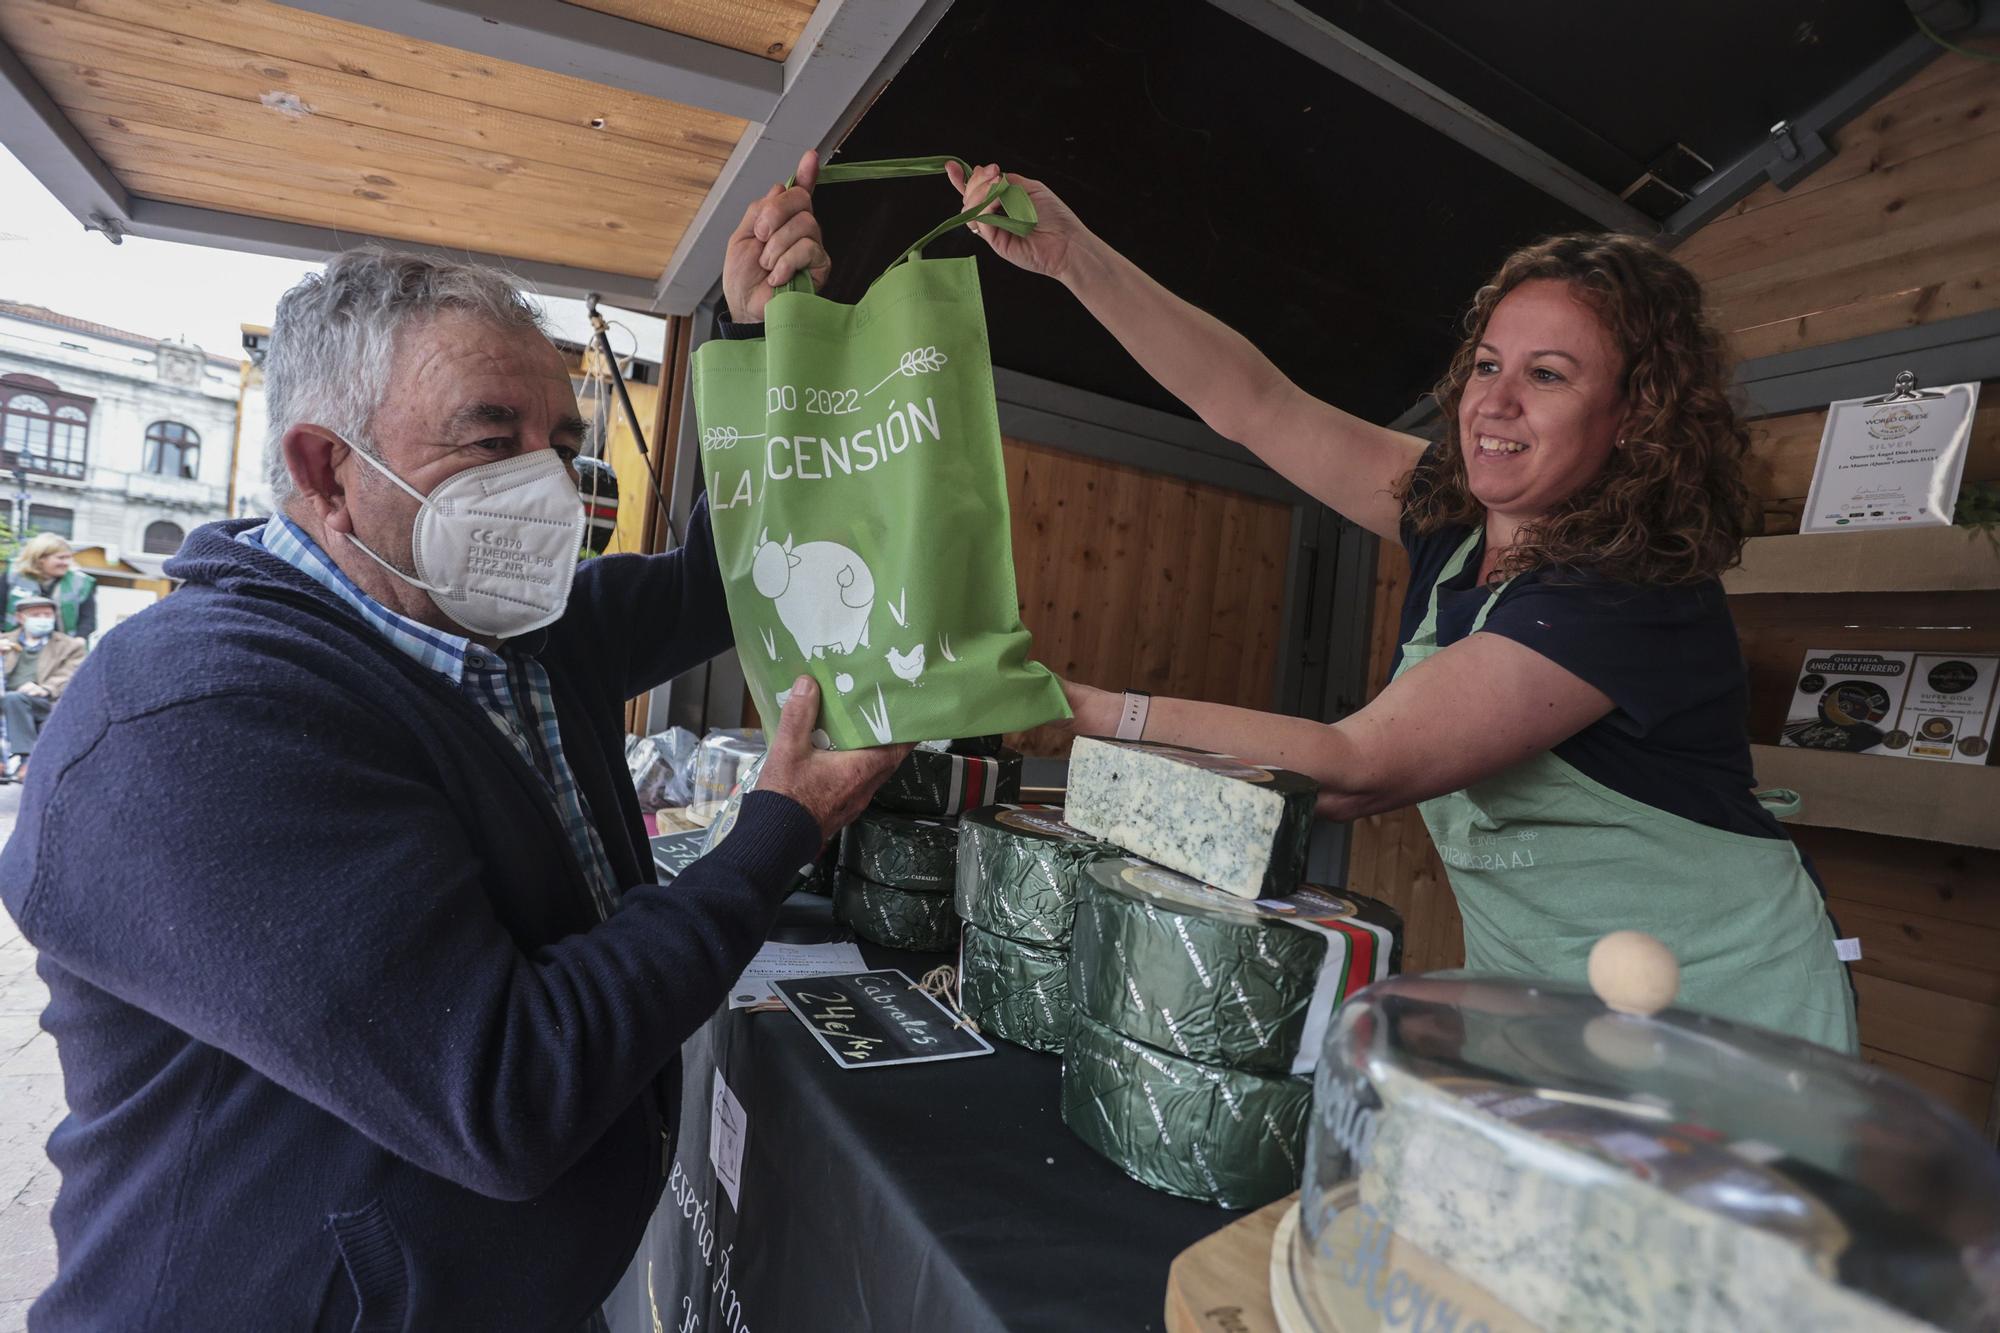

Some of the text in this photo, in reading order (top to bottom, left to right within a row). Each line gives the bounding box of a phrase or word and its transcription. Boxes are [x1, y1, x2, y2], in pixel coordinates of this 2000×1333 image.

[767, 385, 862, 415] DO 2022
[712, 397, 941, 510] LA CENSIÓN
[496, 536, 522, 550] 0370
[467, 556, 523, 572] FFP2 NR
[482, 547, 533, 564] MEDICAL
[1809, 662, 1837, 671] ANGEL
[1858, 664, 1900, 673] HERRERO
[1173, 916, 1213, 989] D.O.P. CABRALES
